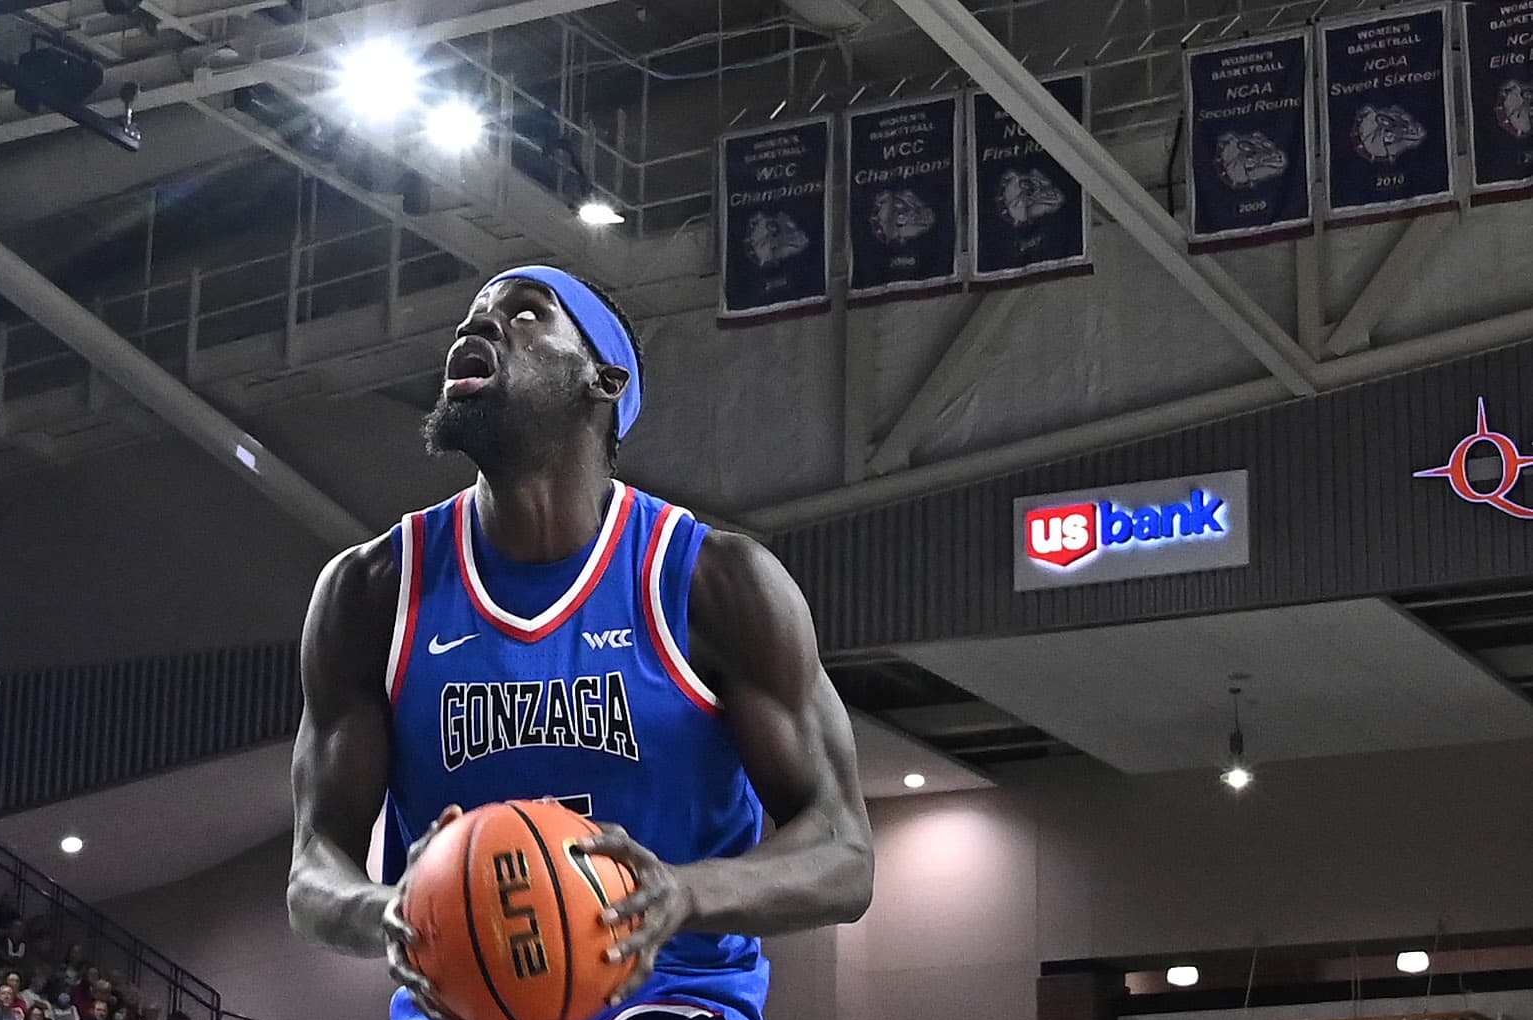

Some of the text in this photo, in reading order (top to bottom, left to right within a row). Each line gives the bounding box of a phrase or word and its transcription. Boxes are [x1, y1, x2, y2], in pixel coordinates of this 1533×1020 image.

[1364, 55, 1408, 72] NCAA
[1226, 80, 1273, 100] NCAA
[1330, 76, 1380, 97] Sweet
[882, 140, 925, 161] WCC
[983, 144, 1021, 162] First
[853, 158, 952, 186] Champions
[1237, 199, 1267, 214] 2009
[1099, 489, 1226, 546] bank
[581, 629, 633, 651] WCC
[440, 671, 639, 772] GONZAGA
